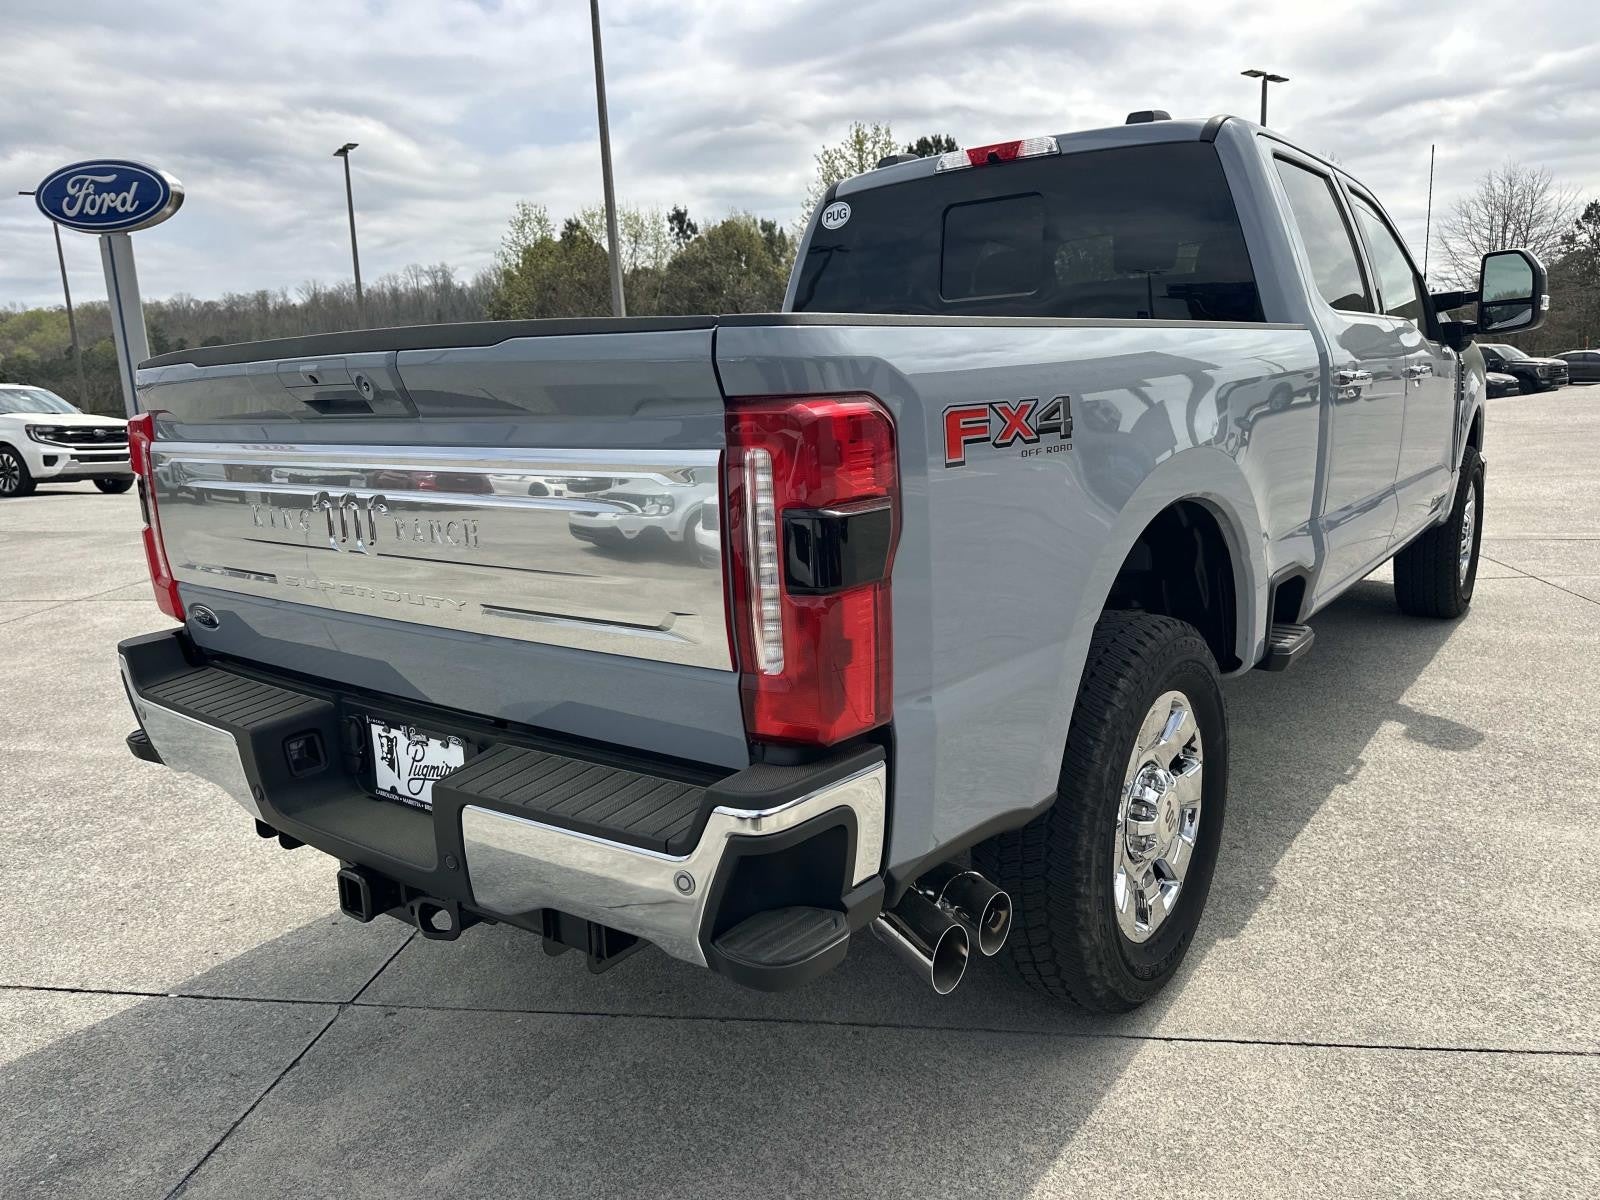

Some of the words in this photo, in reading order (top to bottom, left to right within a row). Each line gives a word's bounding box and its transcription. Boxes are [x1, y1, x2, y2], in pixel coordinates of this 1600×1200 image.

[62, 174, 139, 217] Ford
[826, 208, 847, 223] PUG
[942, 395, 1073, 468] FX4
[1021, 447, 1042, 458] OFF
[1046, 443, 1073, 454] ROAD
[252, 504, 312, 533] KING
[393, 516, 480, 548] RANCH
[285, 575, 375, 598] SUPER
[381, 589, 468, 612] DUTY
[406, 741, 458, 796] Pugmir
